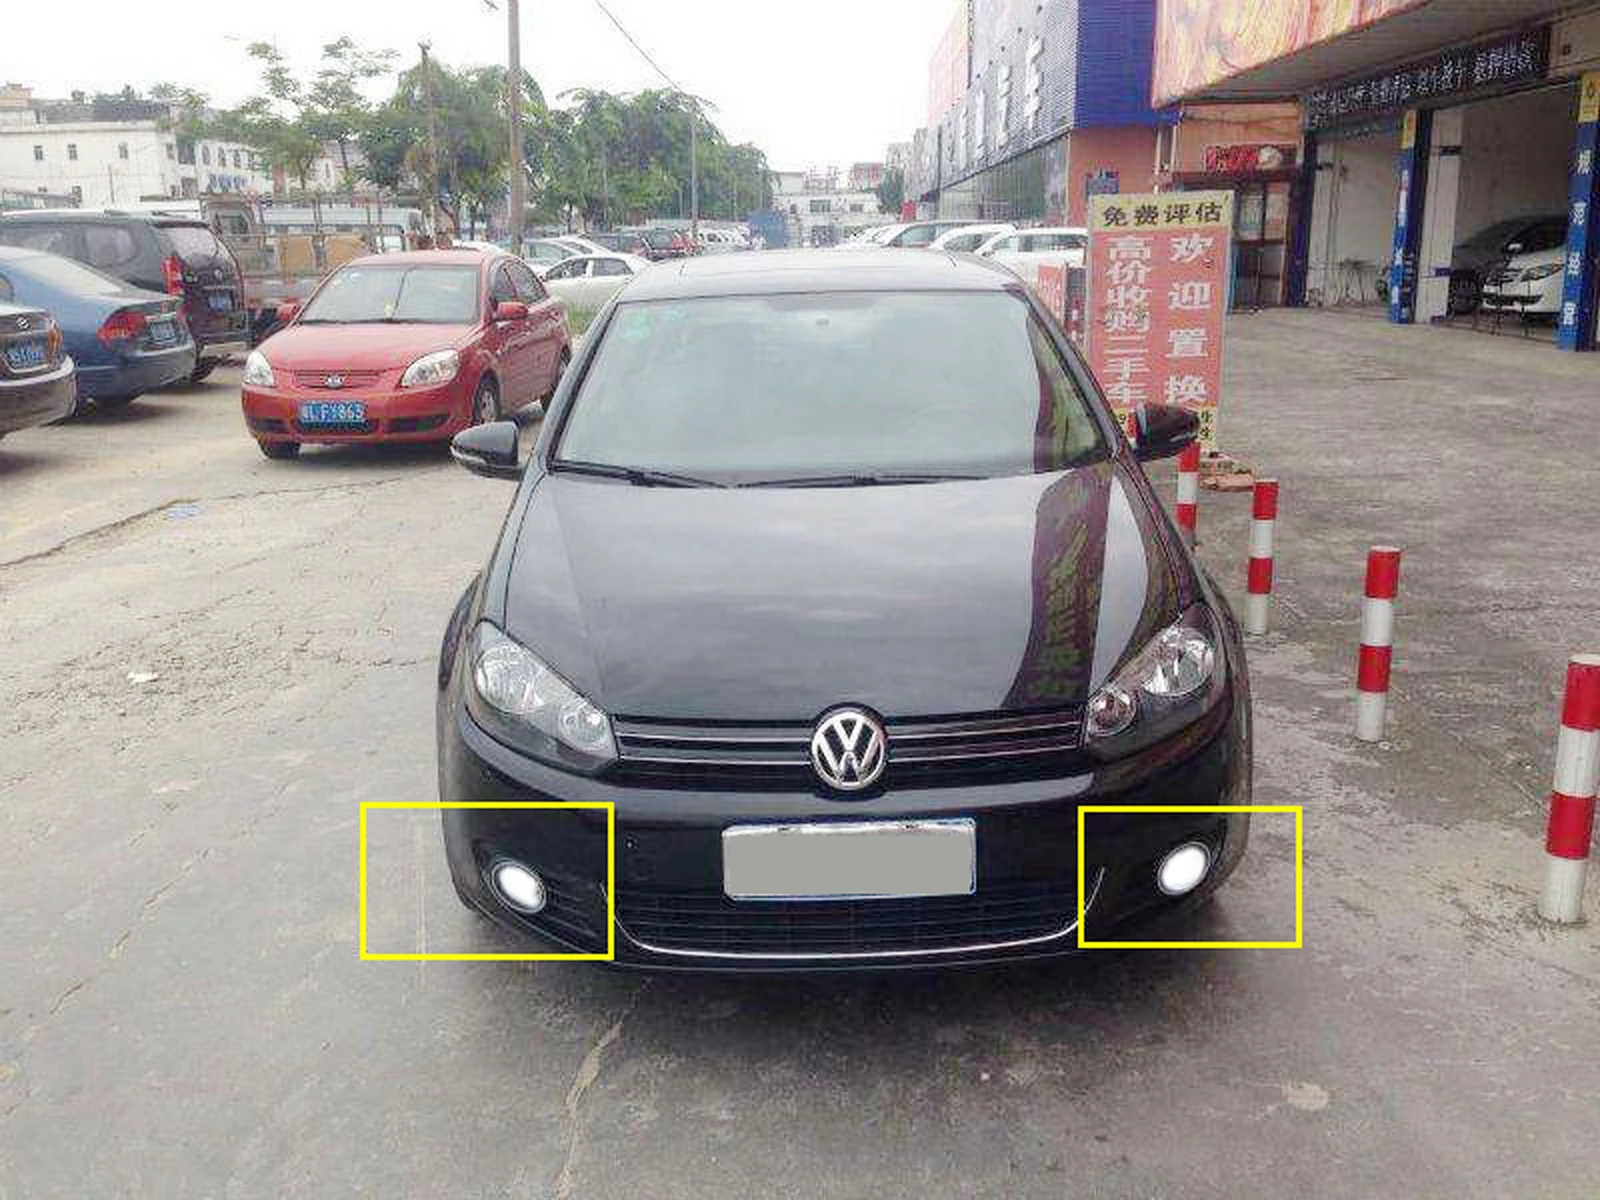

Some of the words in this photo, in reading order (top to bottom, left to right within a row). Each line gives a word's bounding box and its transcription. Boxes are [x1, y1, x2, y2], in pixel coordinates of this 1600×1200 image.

[1103, 202, 1222, 227] 免费评估
[1102, 236, 1153, 403] 高价收购二手车
[1165, 234, 1215, 404] 欢迎置换
